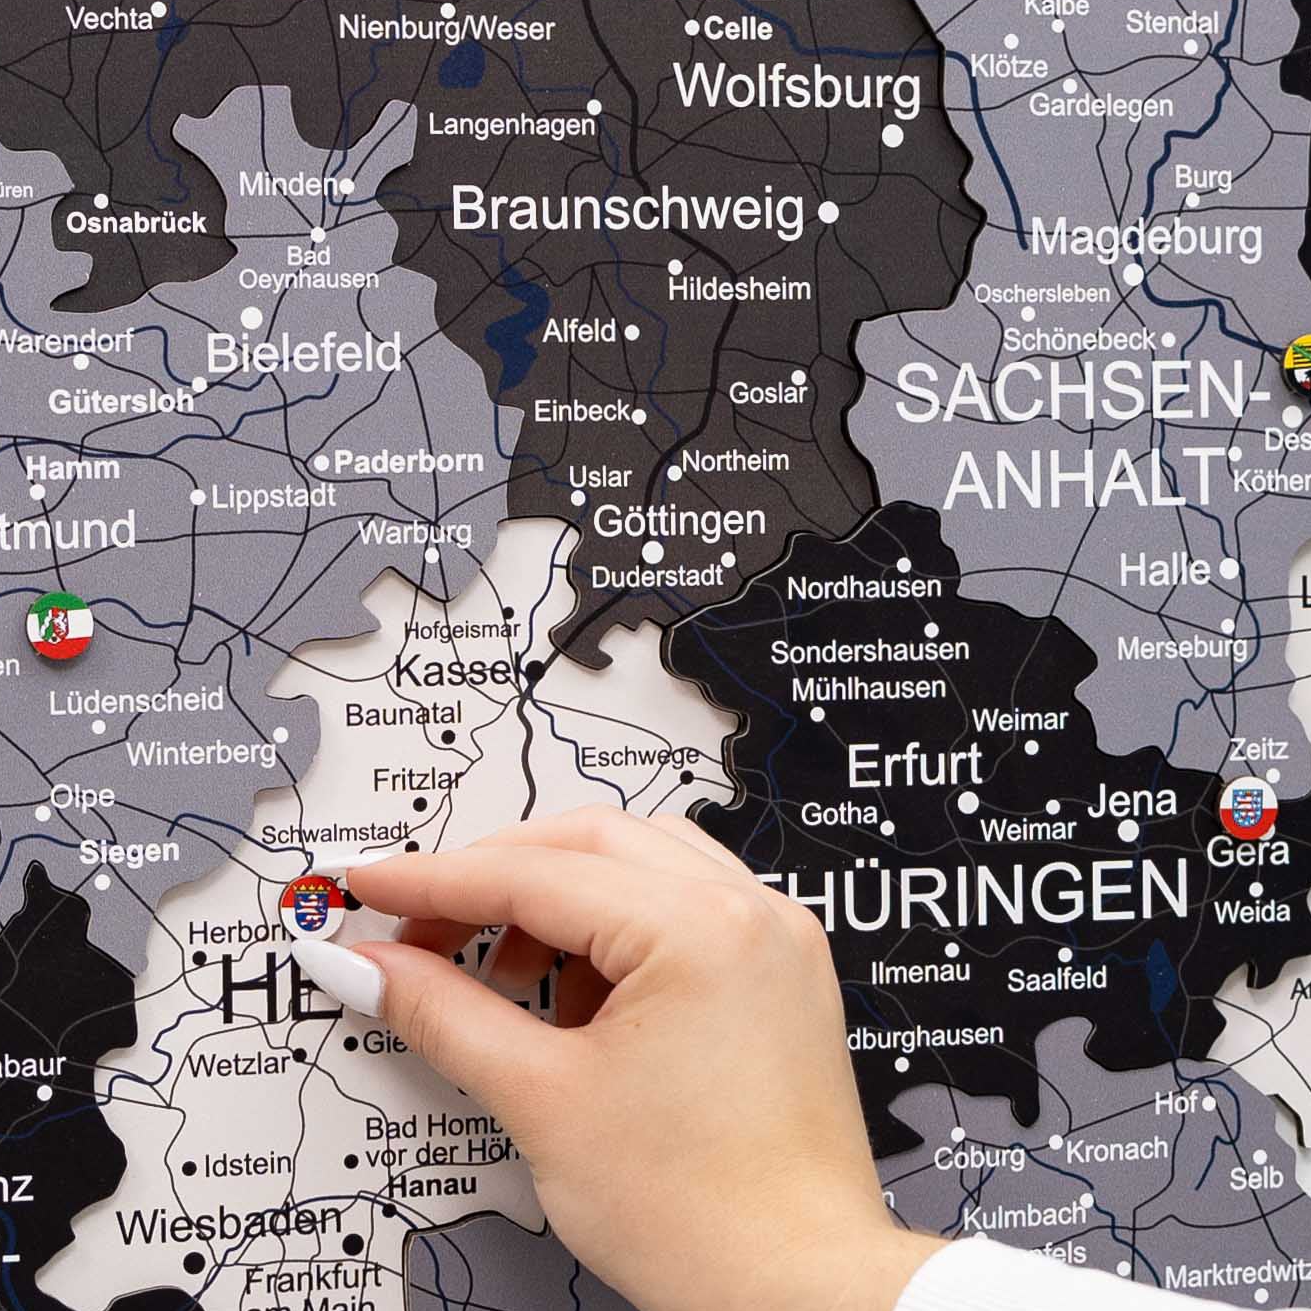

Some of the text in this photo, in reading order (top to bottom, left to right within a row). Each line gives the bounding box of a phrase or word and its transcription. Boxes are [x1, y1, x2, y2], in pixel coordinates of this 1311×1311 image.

[340, 14, 555, 45] Nienburg/Weser
[705, 16, 772, 39] Celle
[673, 63, 920, 120] Wolfsburg
[67, 211, 206, 233] Osnabrück
[453, 185, 803, 241] Braunschweig
[288, 246, 330, 265] Bad
[1032, 217, 1261, 264] Magdeburg
[240, 269, 378, 293] Oeynhausen
[975, 284, 1110, 302] Oschersleben
[208, 331, 400, 372] Bielefeld
[896, 360, 1270, 422] SACHSEN-
[335, 449, 483, 474] Paderborn
[943, 447, 1225, 509] ANHALT
[594, 504, 765, 543] Göttingen
[396, 651, 519, 688] Kassel
[849, 742, 982, 787] Erfurt
[262, 821, 410, 845] Schwalmstadt
[1207, 835, 1289, 866] Gera
[1008, 966, 1106, 992] Saalfeld
[365, 1117, 417, 1140] Bad
[366, 1145, 404, 1167] vor
[416, 1143, 459, 1166] der
[388, 1174, 477, 1198] Hanau
[116, 1204, 342, 1247] Wiesbaden
[245, 1262, 382, 1293] Frankfurt
